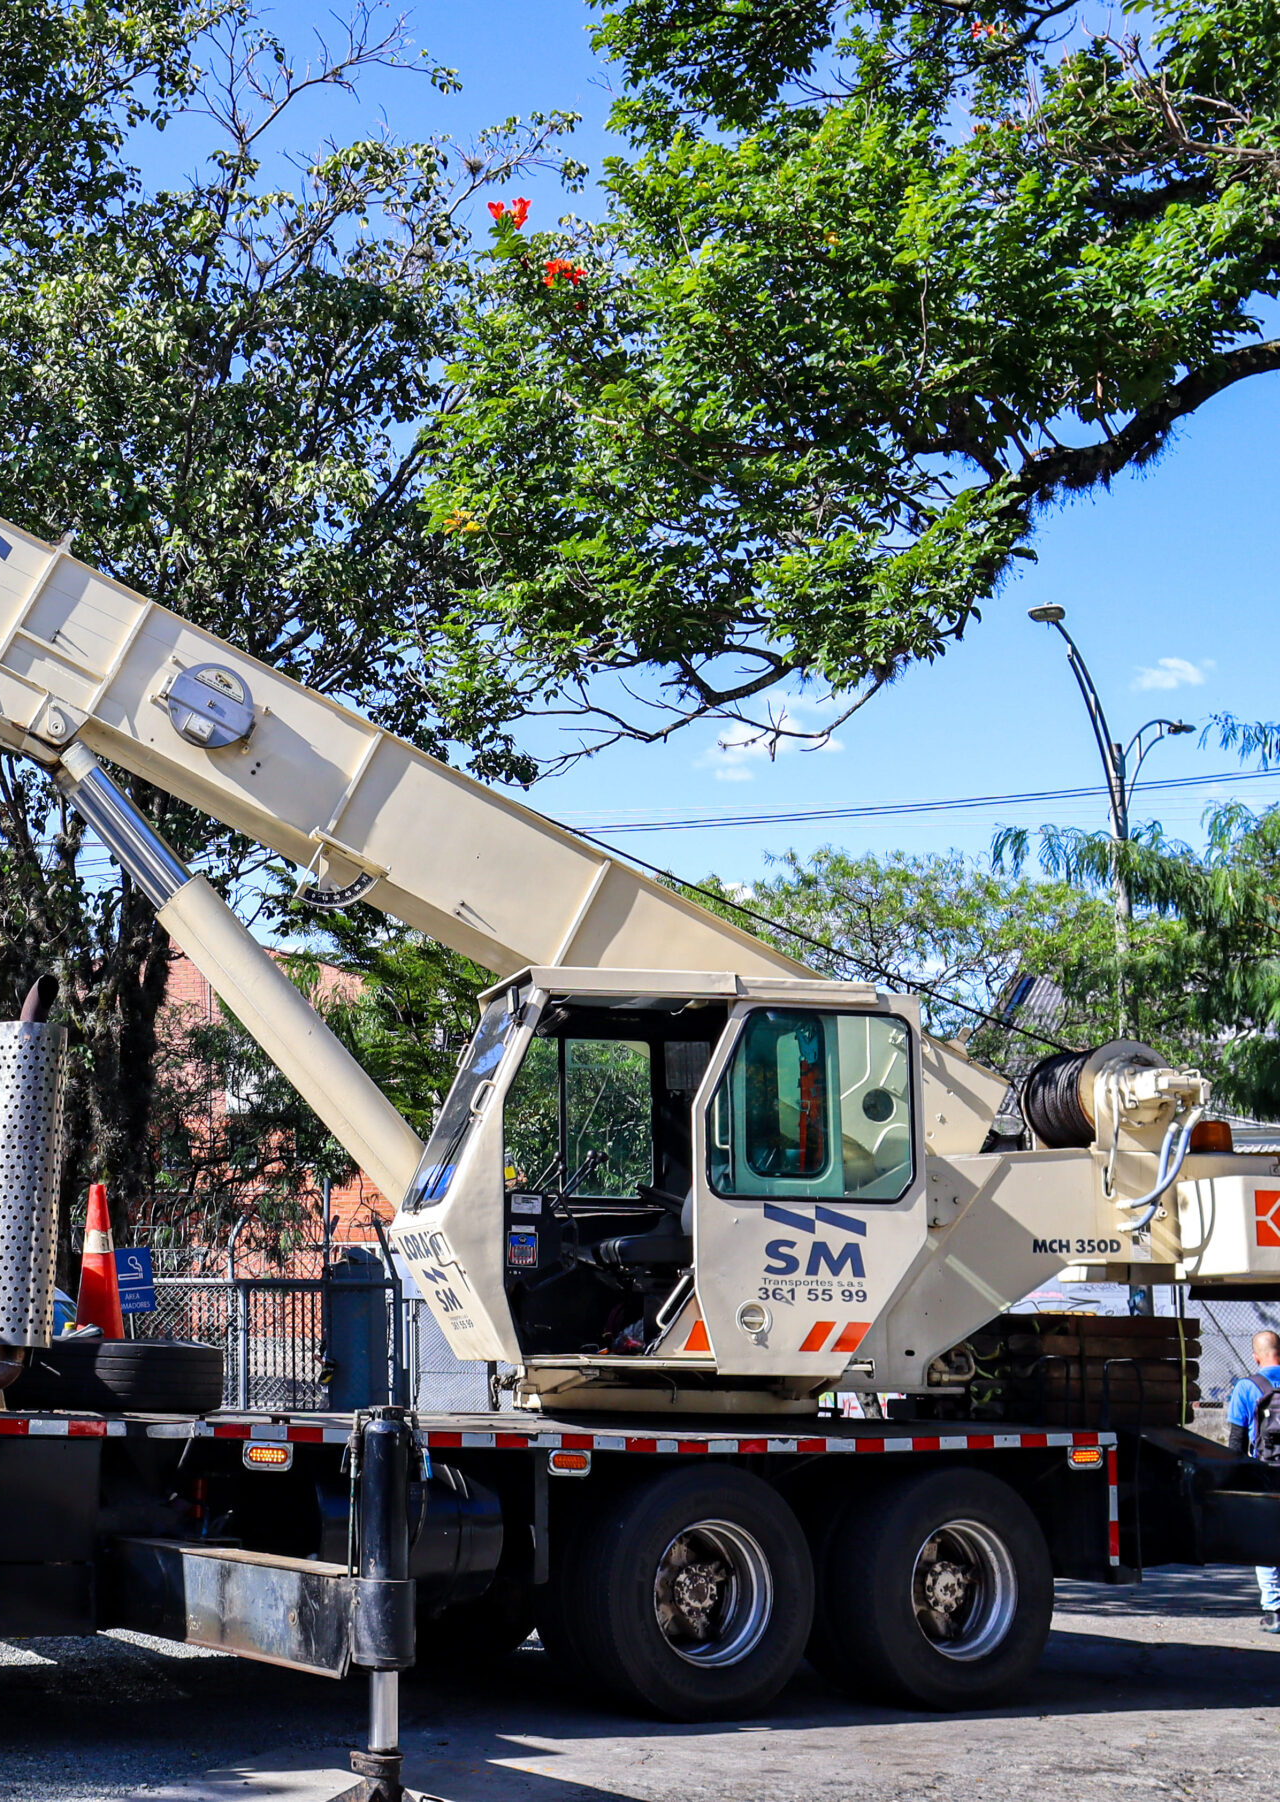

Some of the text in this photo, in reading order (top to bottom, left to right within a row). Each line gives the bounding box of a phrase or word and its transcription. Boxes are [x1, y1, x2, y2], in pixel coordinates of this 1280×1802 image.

[1032, 1239, 1071, 1253] MCH
[1075, 1239, 1122, 1253] 350D
[763, 1239, 866, 1278] SM
[761, 1277, 834, 1288] Transportes
[434, 1287, 464, 1313] SM
[758, 1287, 867, 1303] 361 55 99
